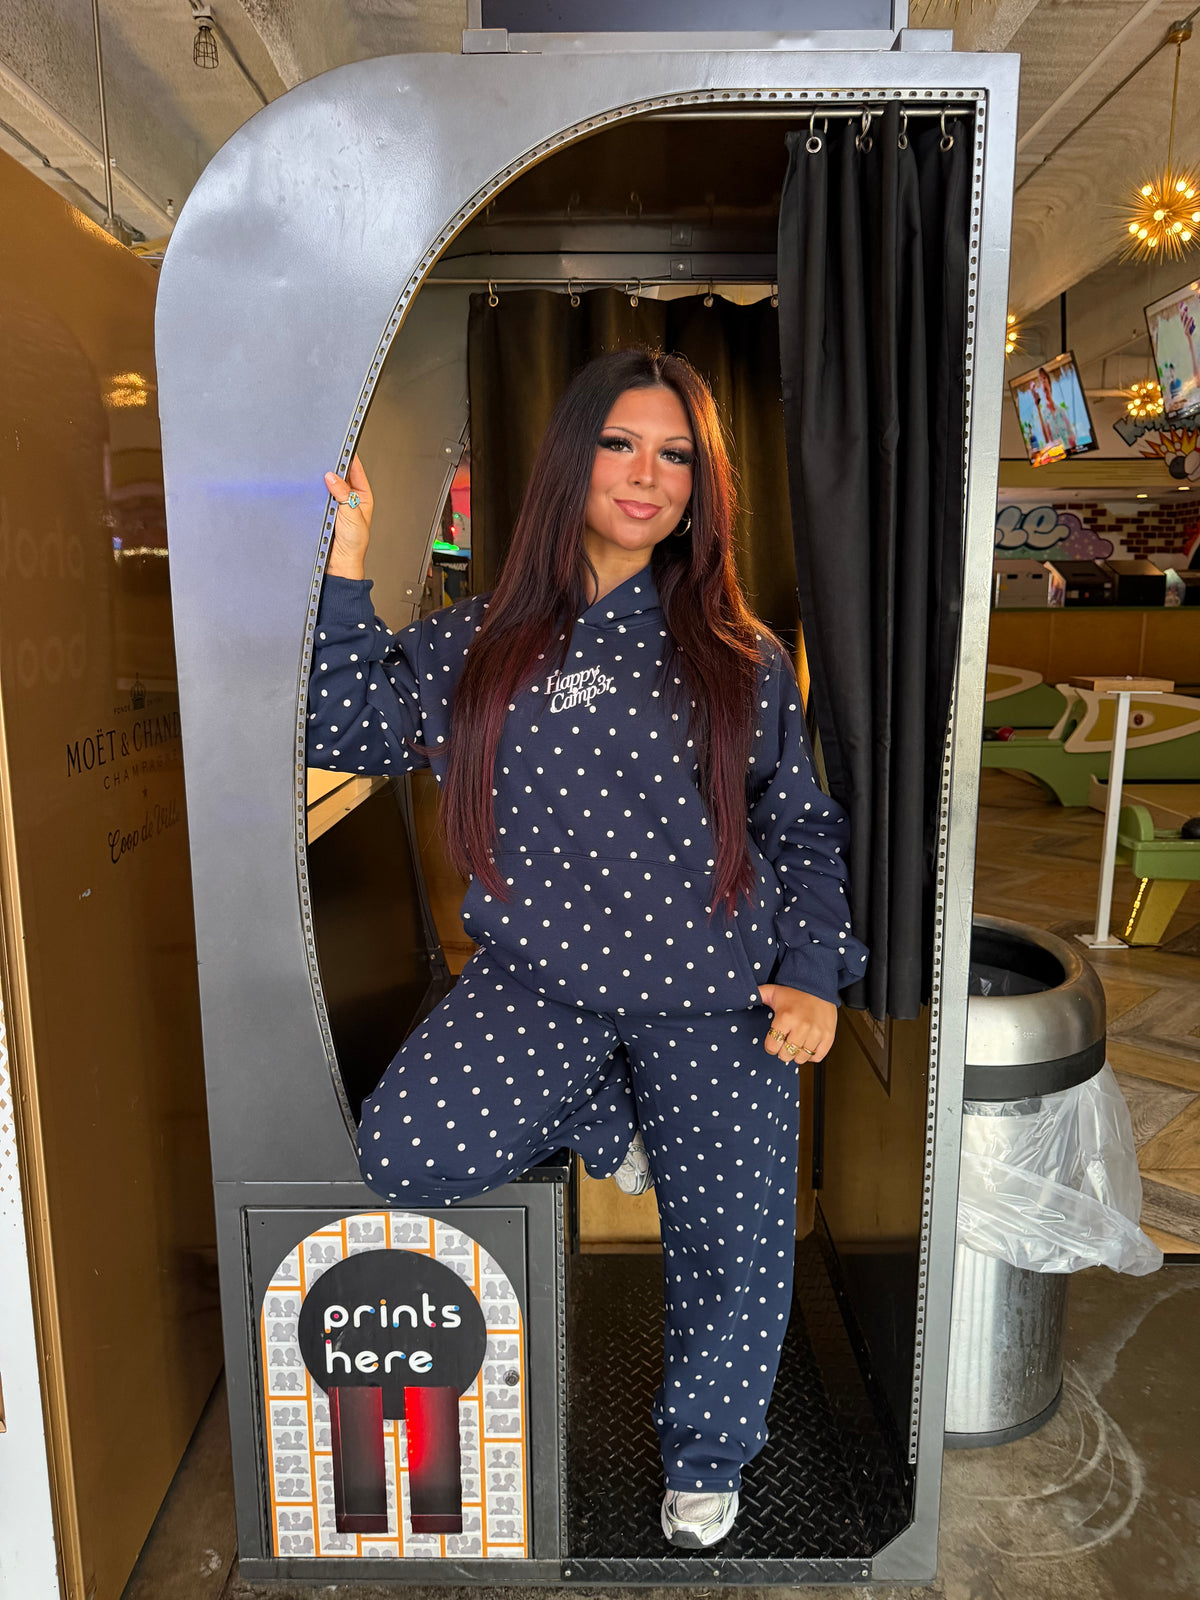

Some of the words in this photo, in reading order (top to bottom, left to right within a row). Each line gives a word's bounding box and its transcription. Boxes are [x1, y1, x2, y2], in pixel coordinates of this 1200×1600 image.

[544, 665, 601, 695] Happy
[550, 674, 615, 714] Camp3r
[66, 728, 117, 778] MOËT
[121, 732, 131, 757] &
[108, 829, 139, 864] Coop
[142, 810, 154, 842] de
[323, 1292, 462, 1334] prints
[325, 1339, 433, 1374] here
